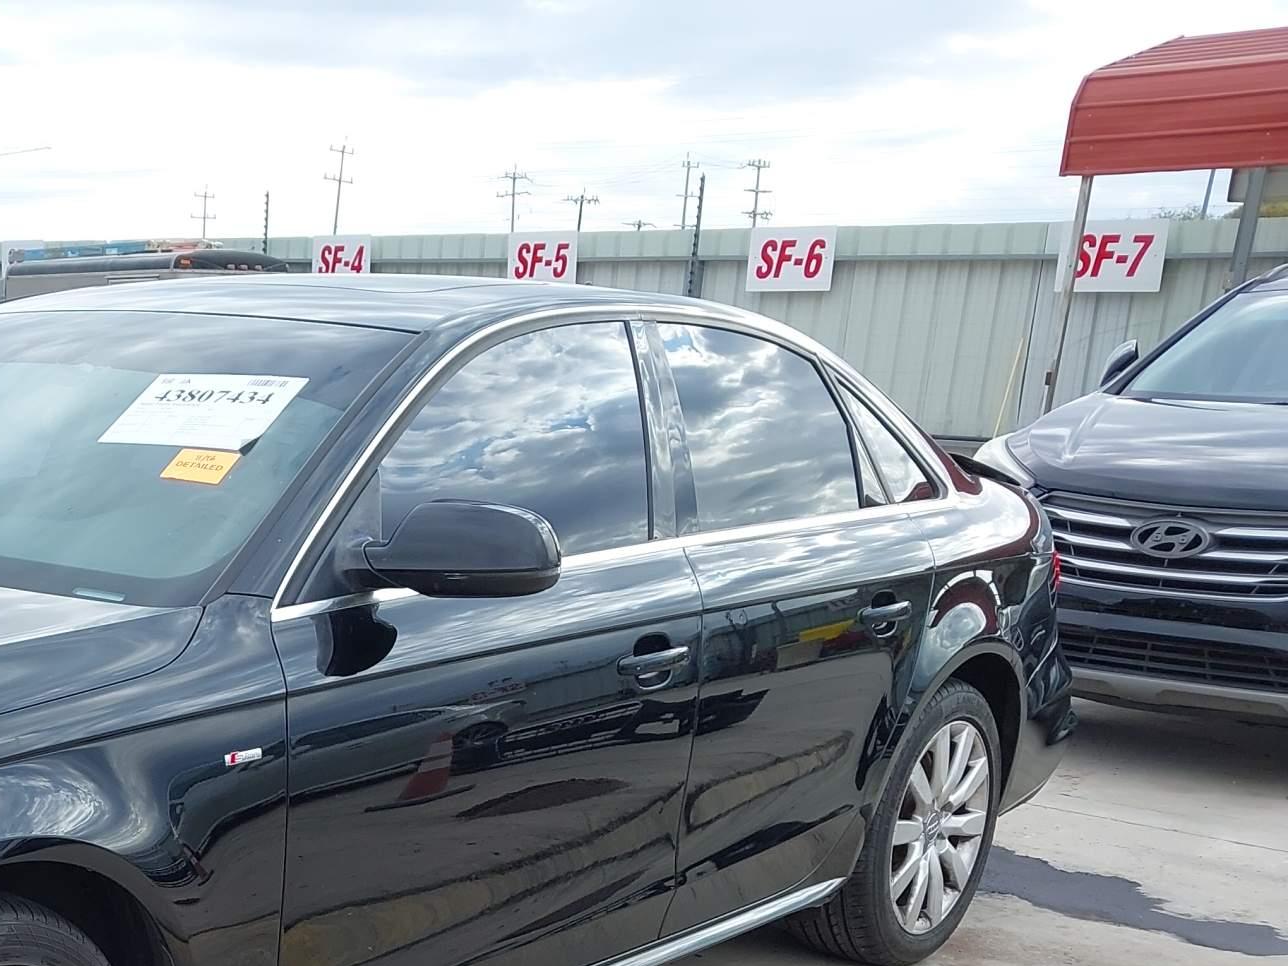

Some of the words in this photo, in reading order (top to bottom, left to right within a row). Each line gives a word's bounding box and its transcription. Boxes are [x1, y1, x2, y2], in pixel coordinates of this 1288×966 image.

[318, 244, 365, 274] SF-4
[514, 243, 570, 279] SF-5
[755, 238, 826, 279] SF-6
[1074, 233, 1155, 279] SF-7
[154, 389, 275, 405] 43807434
[175, 460, 224, 472] DETAILED
